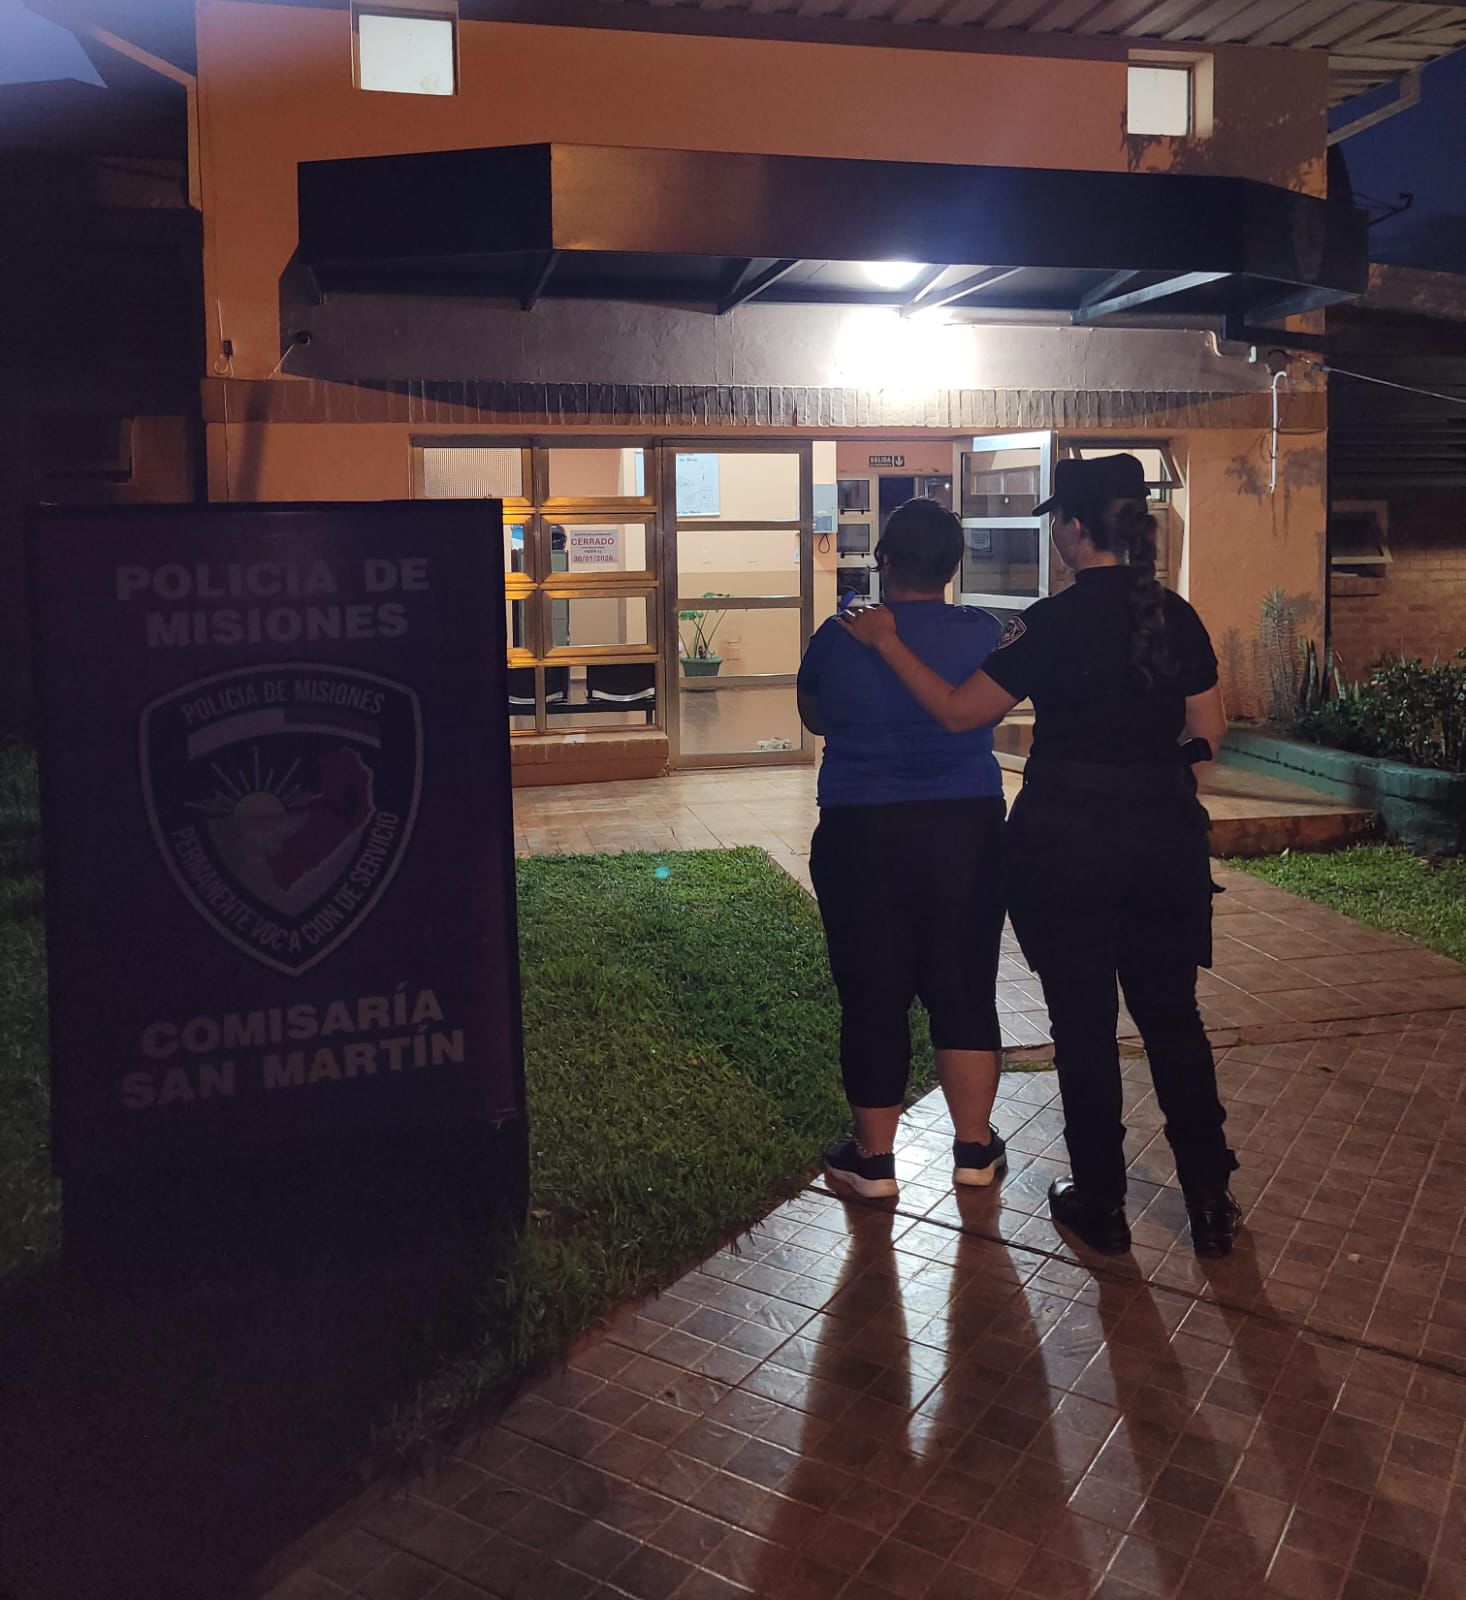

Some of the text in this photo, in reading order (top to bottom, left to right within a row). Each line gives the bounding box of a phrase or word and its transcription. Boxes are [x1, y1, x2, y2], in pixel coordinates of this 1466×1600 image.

[571, 537, 614, 546] CERRADO
[363, 557, 430, 592] DE
[146, 602, 409, 648] MISIONES
[181, 679, 385, 725] POLICIA DE MISIONES
[168, 825, 258, 930] PERMANENTE
[333, 882, 364, 910] DE
[350, 811, 400, 888] SERVICIO
[141, 981, 444, 1058] COMISARÍA
[120, 1024, 465, 1110] SAN MARTÍN
